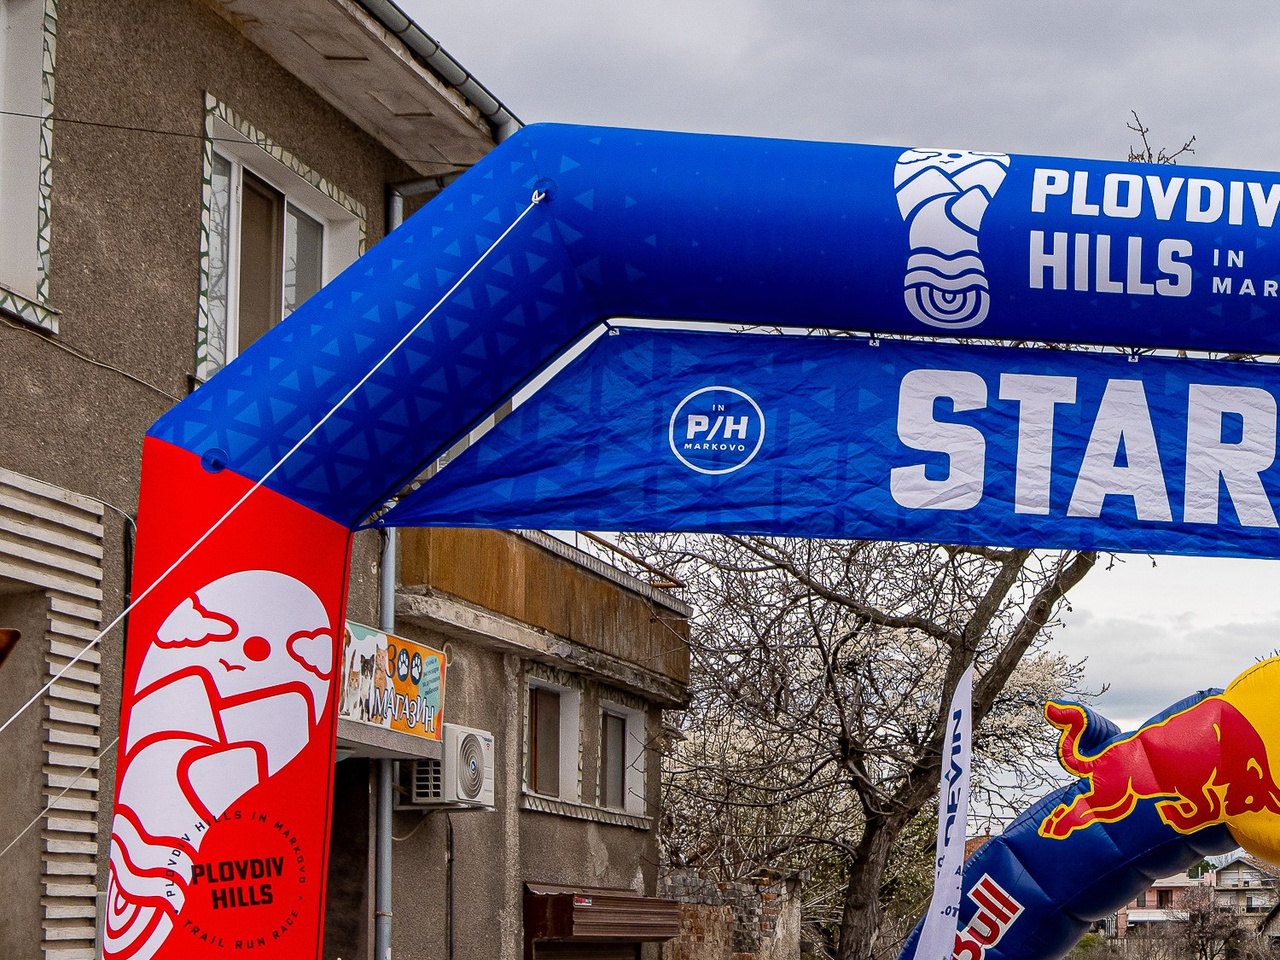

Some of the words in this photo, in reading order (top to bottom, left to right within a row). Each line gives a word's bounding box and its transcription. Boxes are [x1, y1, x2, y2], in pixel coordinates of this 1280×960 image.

[1028, 231, 1193, 298] HILLS
[1212, 248, 1246, 269] IN
[712, 404, 725, 412] IN
[686, 414, 749, 441] P/H
[683, 443, 745, 452] MARKOVO
[374, 685, 435, 733] МАГАЗИН
[165, 833, 191, 898] PLOVDIV
[194, 810, 242, 832] HILLS
[251, 811, 268, 823] IN
[273, 820, 306, 884] MARKOVO
[191, 856, 284, 885] PLOVDIV
[211, 883, 273, 910] HILLS
[182, 919, 225, 948] TRAIL
[234, 936, 266, 950] RUN
[271, 909, 299, 940] RACE
